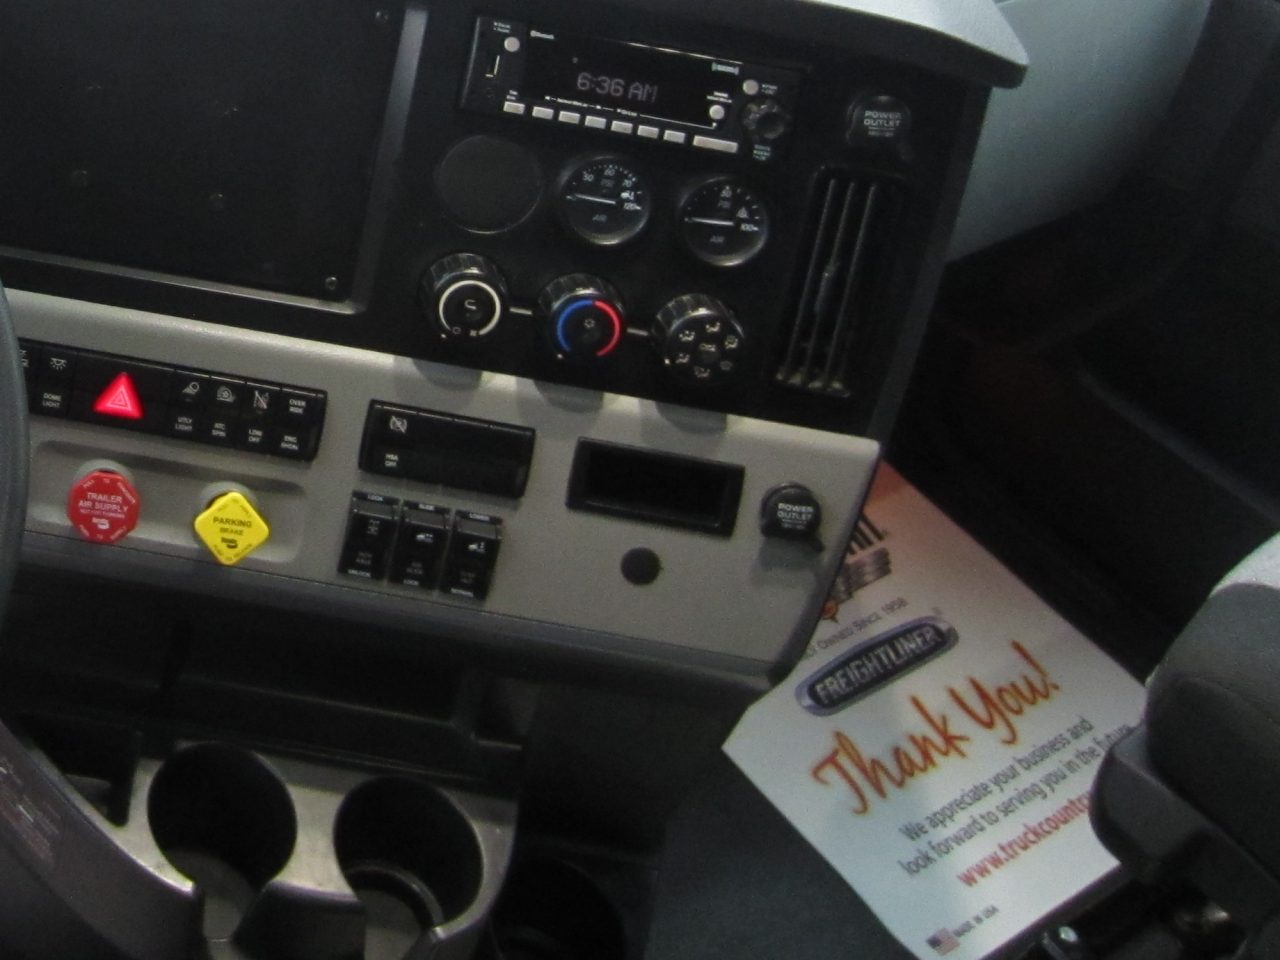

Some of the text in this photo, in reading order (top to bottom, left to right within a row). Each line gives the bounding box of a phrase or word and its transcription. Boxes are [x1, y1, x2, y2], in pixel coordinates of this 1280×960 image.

[577, 72, 659, 103] 6:36 AM
[864, 109, 902, 120] POWER
[863, 117, 901, 127] OUTLET
[87, 492, 123, 504] TRAILER
[78, 500, 129, 513] AIR SUPPLY
[778, 502, 814, 513] POWER
[213, 515, 252, 528] PARKING
[777, 510, 813, 521] OUTLET
[219, 526, 244, 536] BRAKE
[814, 625, 939, 704] FREIGHTLINER
[811, 640, 1060, 815] Thank You!
[898, 716, 1094, 841] We appreciate your business and
[897, 847, 937, 875] look
[928, 814, 986, 858] forward
[979, 808, 1000, 827] to
[996, 781, 1048, 817] serving
[1040, 766, 1067, 793] you
[1064, 755, 1080, 775] in
[1075, 744, 1101, 766] the
[957, 790, 1091, 887] www.truckcountr
